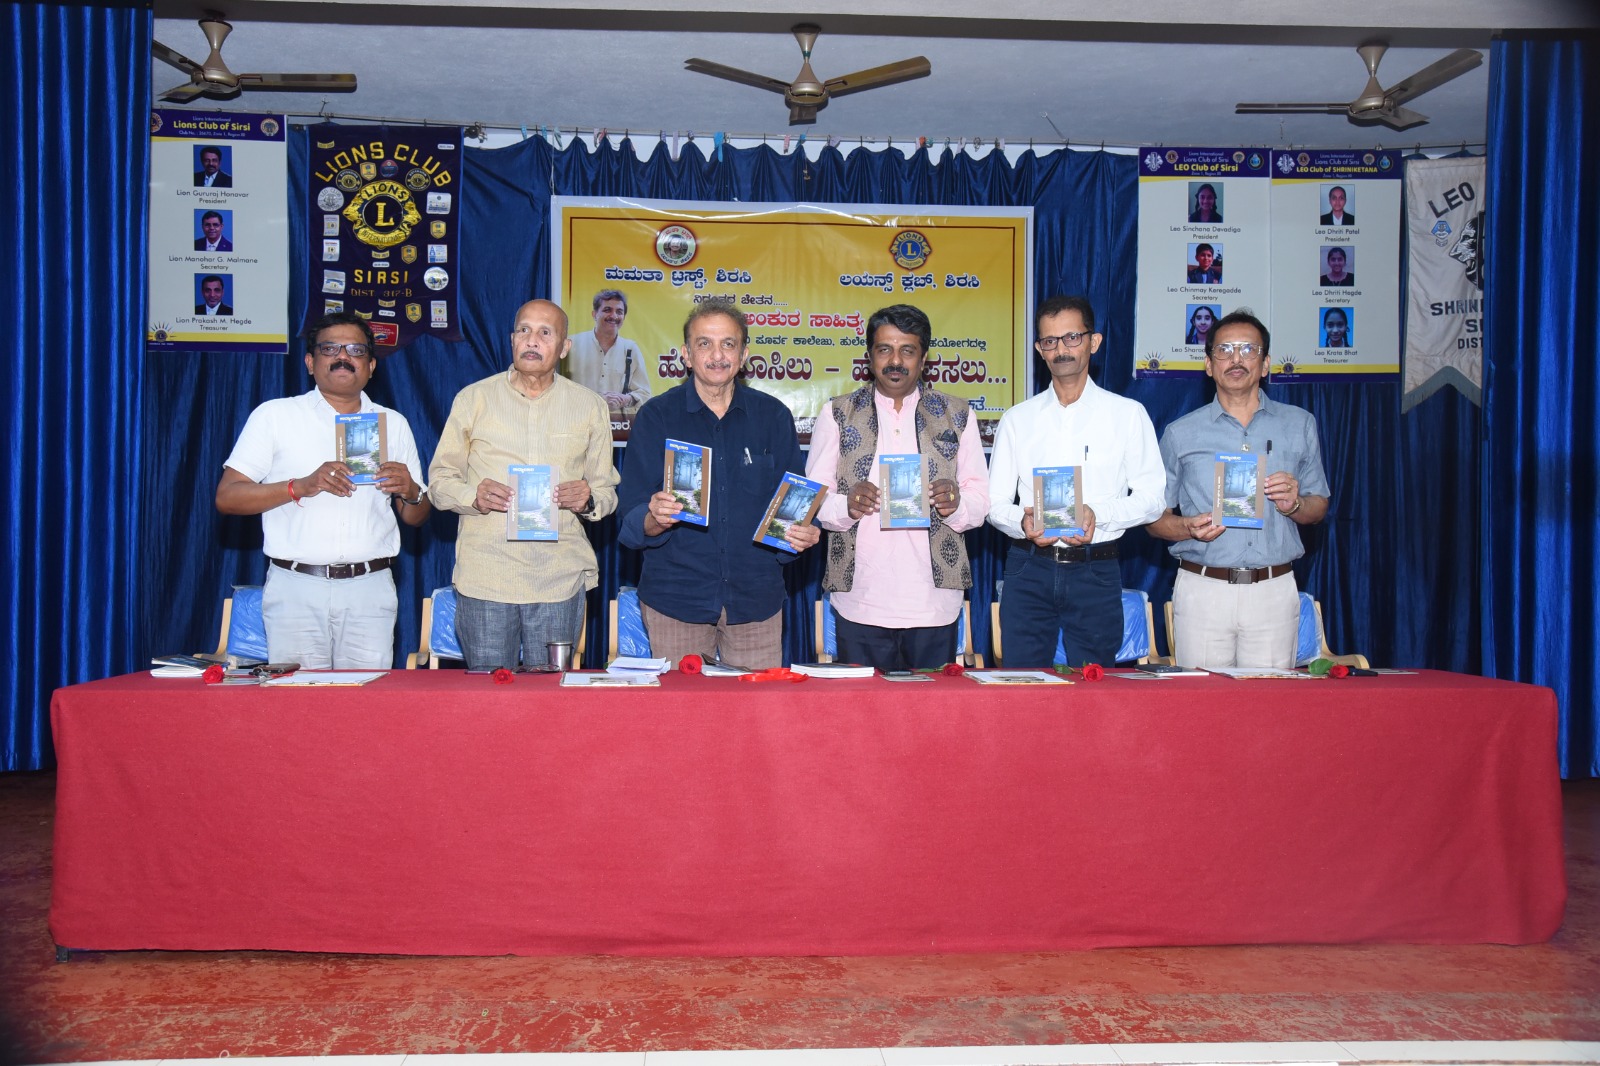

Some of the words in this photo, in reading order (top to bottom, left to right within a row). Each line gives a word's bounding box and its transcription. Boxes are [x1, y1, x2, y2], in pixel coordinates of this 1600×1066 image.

[174, 121, 197, 129] Lions
[231, 123, 250, 131] Sirsi
[315, 142, 385, 182] LIONS
[394, 144, 452, 187] CLUB
[364, 184, 408, 201] LIONS
[1428, 181, 1475, 218] LEO
[374, 202, 395, 226] L
[906, 243, 916, 256] L
[354, 269, 409, 284] SIRSI
[605, 267, 663, 282] ಮಮತಾ
[672, 268, 707, 288] ಟ್ರಸ್ಟ್,
[716, 269, 752, 283] ಶಿರಸಿ
[840, 272, 894, 292] ಲಯನ್ಸ್
[945, 273, 980, 288] ಶಿರಸಿ
[350, 288, 375, 297] DIST
[810, 311, 864, 335] ಸಾಹಿತ್ಯ
